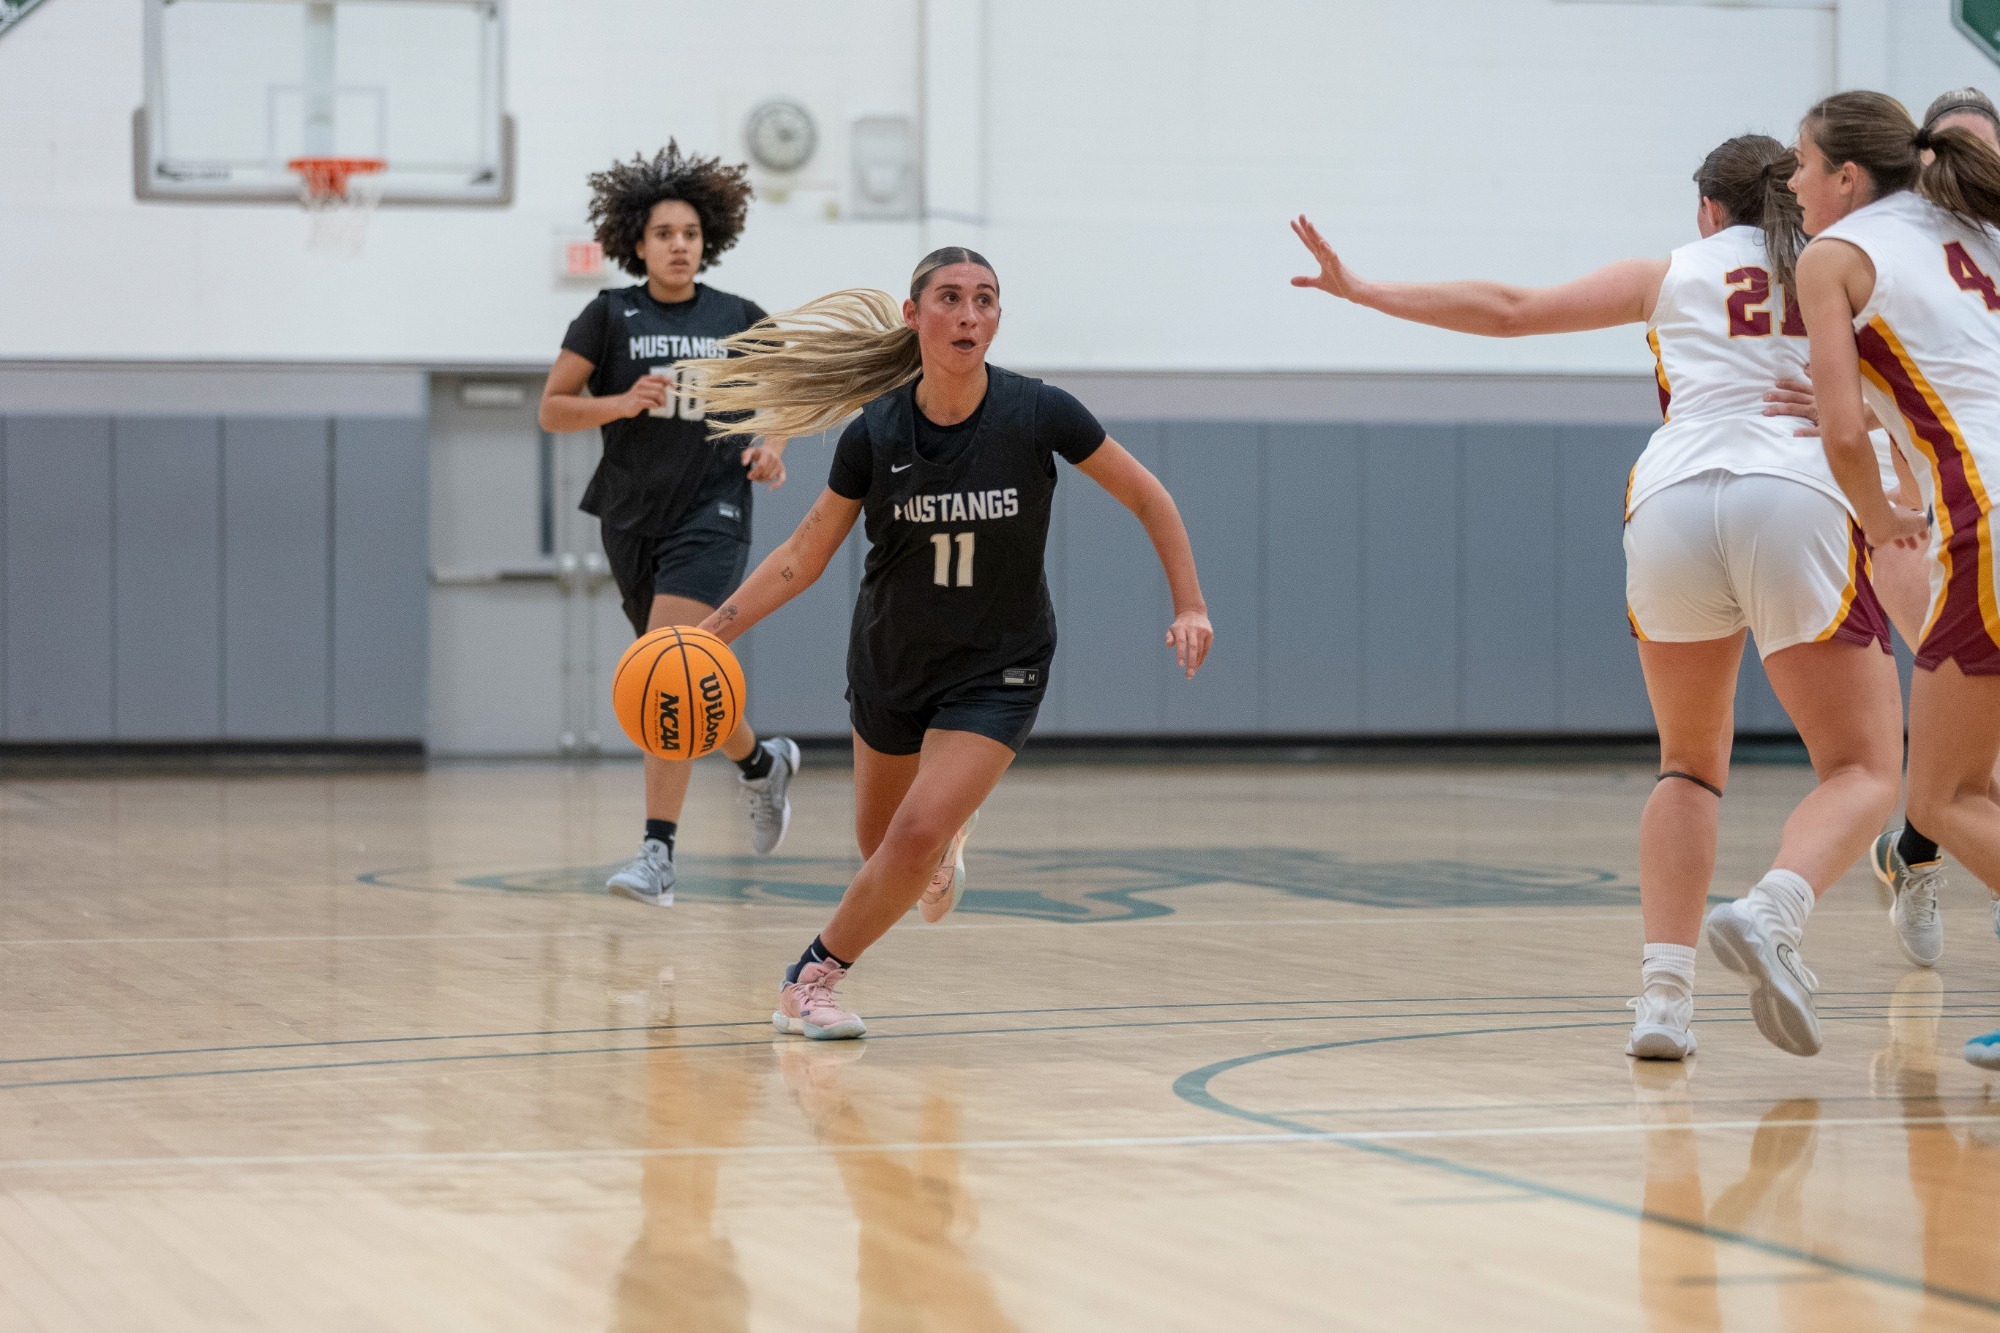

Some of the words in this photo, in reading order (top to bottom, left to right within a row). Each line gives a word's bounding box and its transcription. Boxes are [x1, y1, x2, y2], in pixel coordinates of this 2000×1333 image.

[1942, 240, 2000, 312] 4
[930, 532, 975, 587] 11
[1028, 673, 1036, 682] M
[660, 691, 680, 751] NCAA
[699, 672, 725, 753] Wilson
